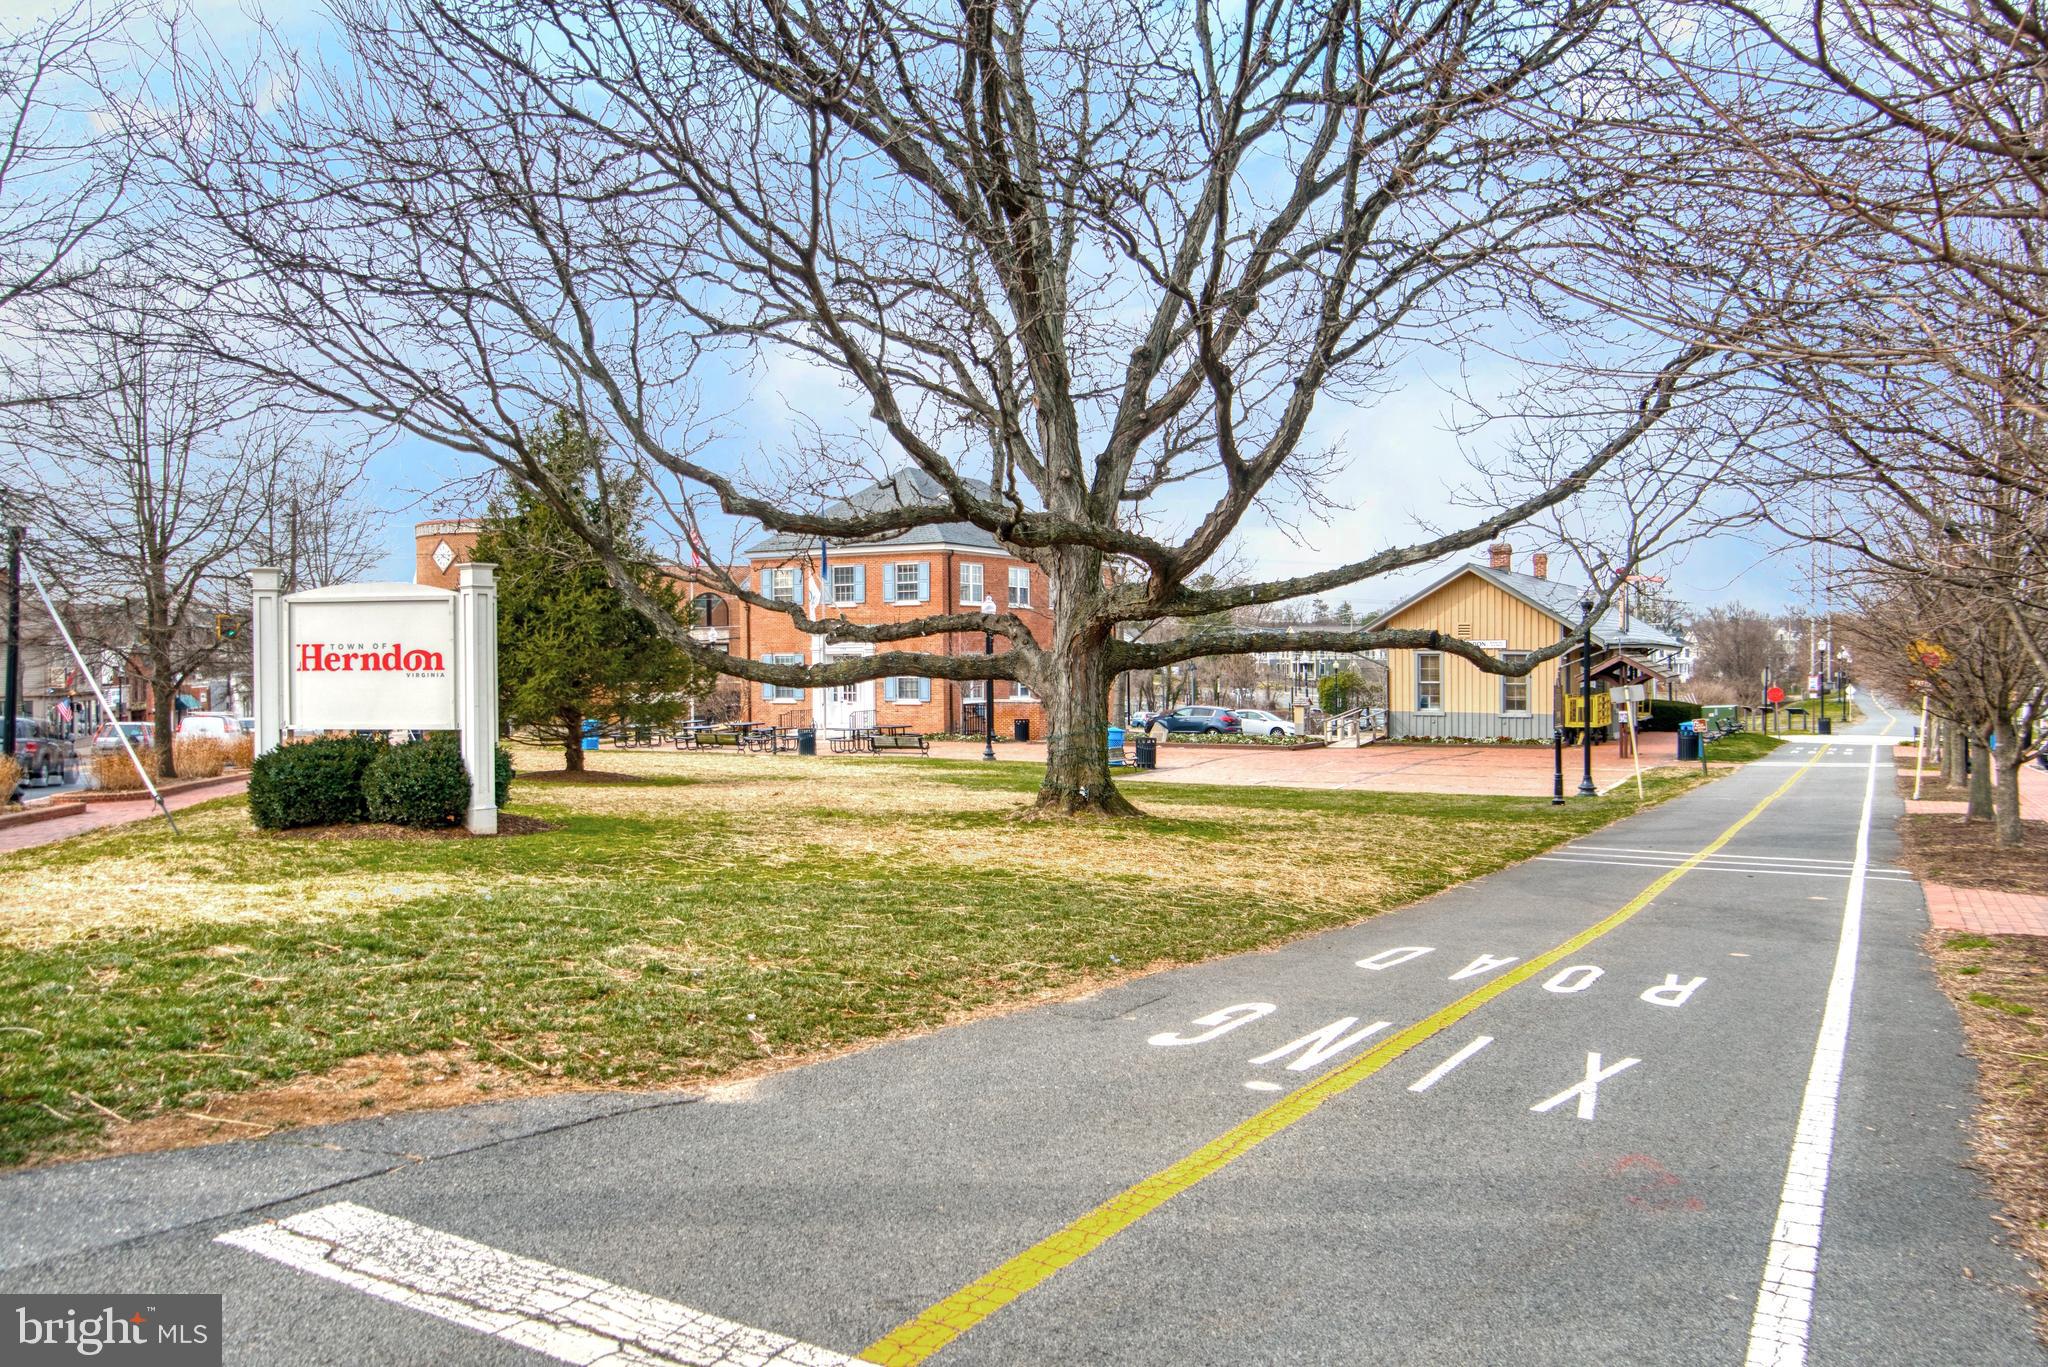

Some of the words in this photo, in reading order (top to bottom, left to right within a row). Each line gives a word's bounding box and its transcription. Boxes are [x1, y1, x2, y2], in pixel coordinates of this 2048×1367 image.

[296, 643, 445, 672] Herndon
[1355, 946, 1708, 1009] ROAD
[1147, 1001, 1642, 1121] XING
